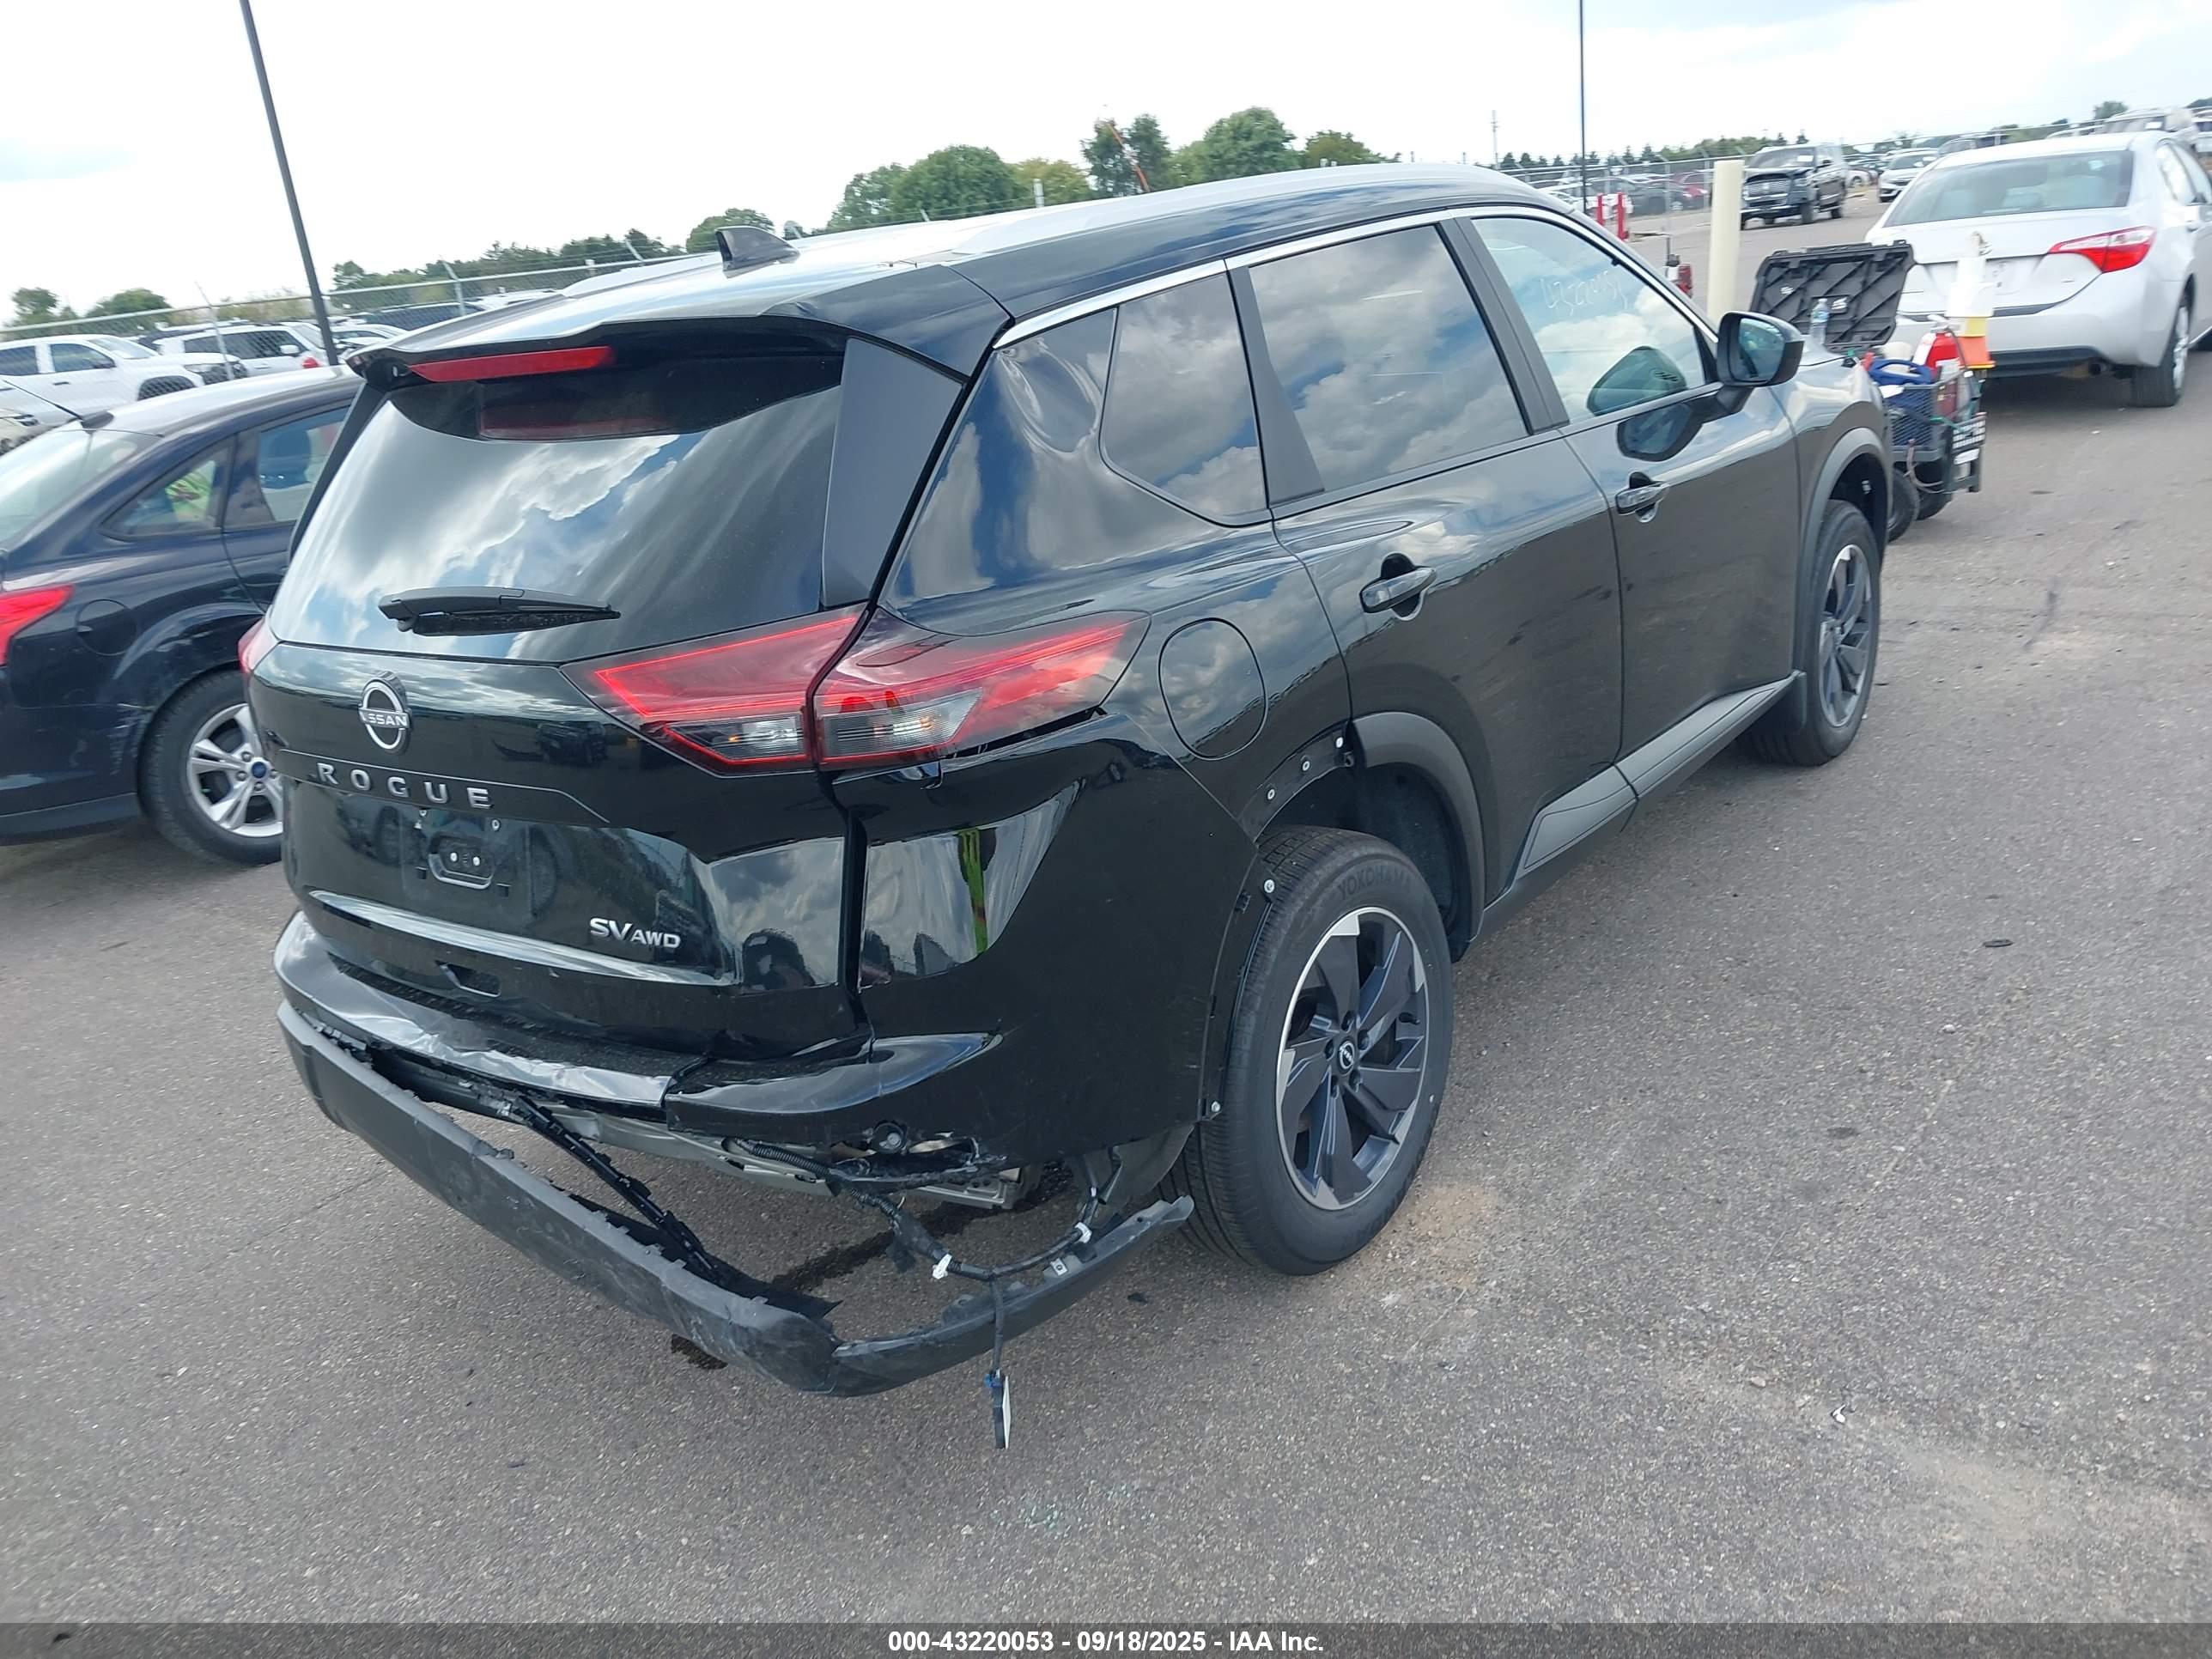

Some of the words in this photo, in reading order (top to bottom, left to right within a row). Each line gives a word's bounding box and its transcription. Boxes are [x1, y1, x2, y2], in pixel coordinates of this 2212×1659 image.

[317, 762, 494, 810] ROGUE
[589, 917, 634, 941] SV
[629, 928, 682, 949] AWD
